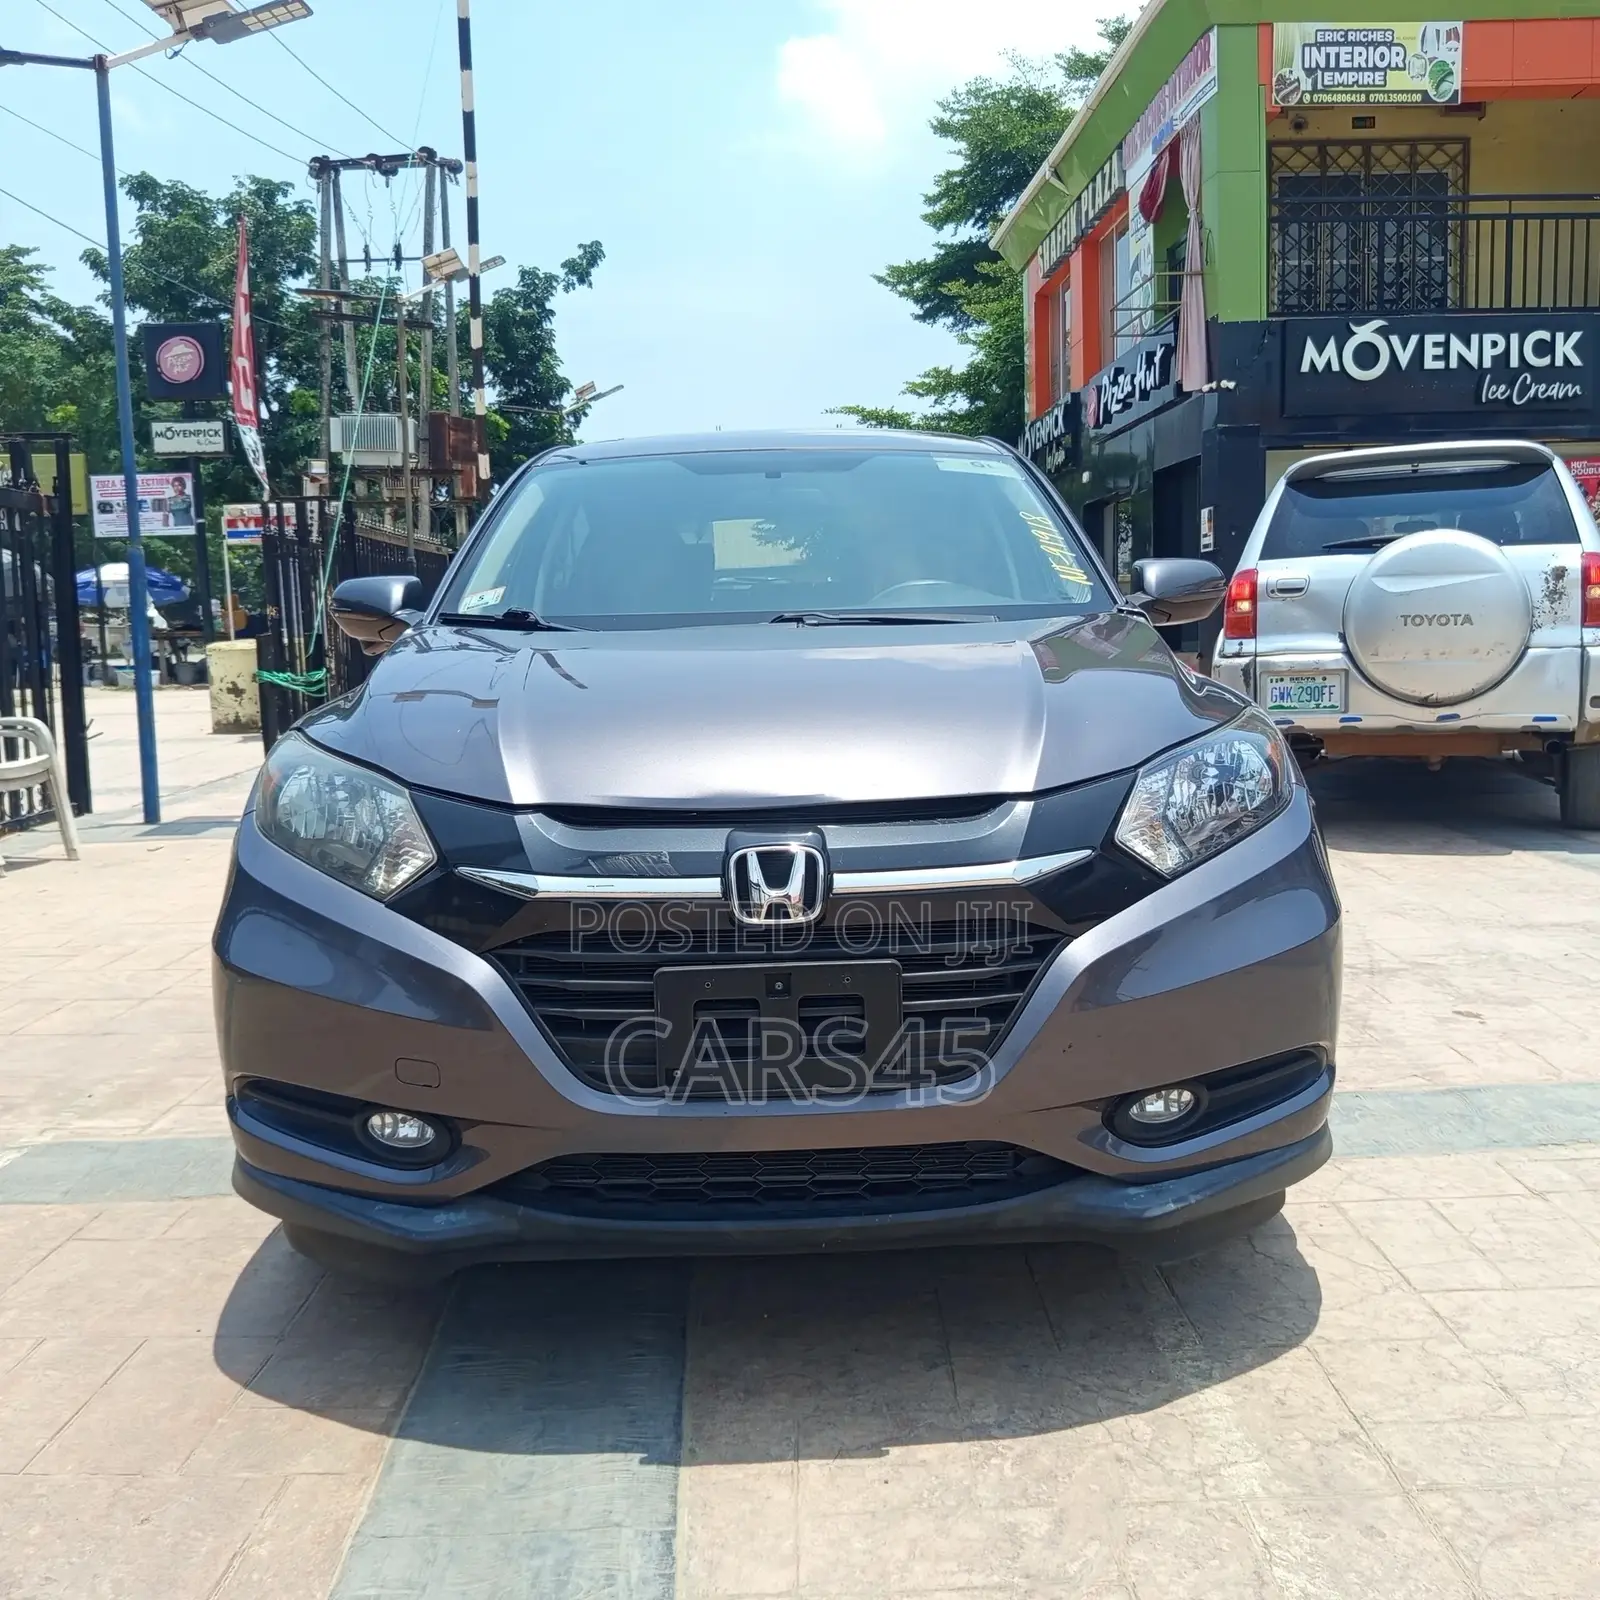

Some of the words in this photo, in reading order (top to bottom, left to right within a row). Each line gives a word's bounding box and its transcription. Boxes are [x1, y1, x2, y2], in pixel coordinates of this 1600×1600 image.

[1316, 30, 1346, 42] ERIC
[1347, 30, 1393, 42] RICHES
[1303, 45, 1405, 69] INTERIOR
[1323, 71, 1385, 85] EMPIRE
[1312, 93, 1366, 103] 07064806418
[1369, 93, 1422, 103] 07013500100
[1081, 150, 1119, 232] PLAZA
[1099, 366, 1132, 425] Pizza
[1134, 343, 1165, 401] Hut
[1481, 373, 1510, 403] Ice
[1511, 372, 1583, 406] Cream
[1571, 461, 1588, 469] HUT
[1400, 614, 1474, 627] TOYOTA
